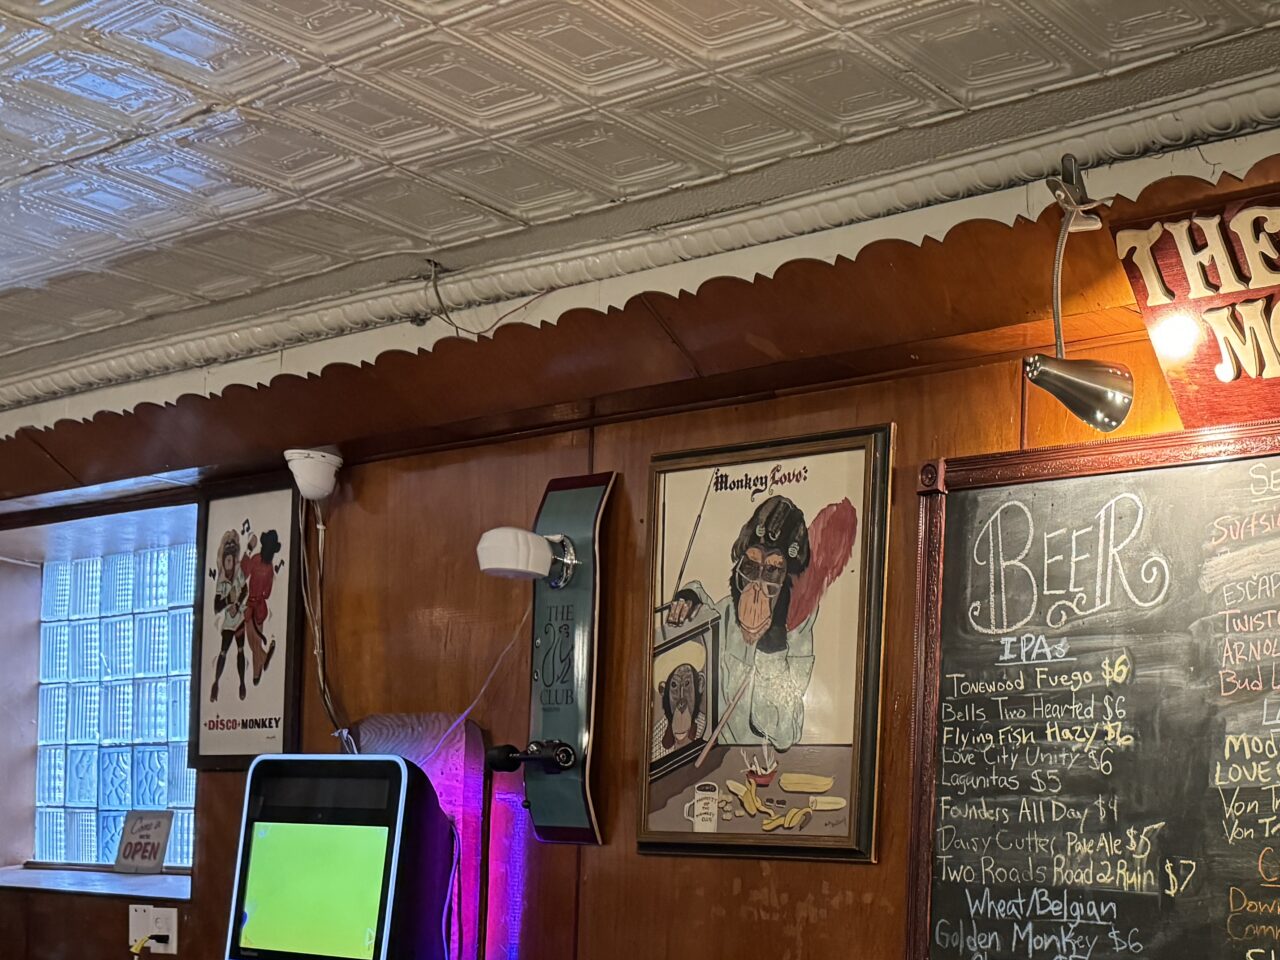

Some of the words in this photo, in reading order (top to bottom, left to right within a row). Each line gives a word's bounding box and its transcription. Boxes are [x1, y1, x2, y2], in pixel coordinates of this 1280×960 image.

[714, 470, 768, 502] Monkey
[547, 605, 574, 621] THE
[1000, 634, 1069, 661] IPAs
[1036, 668, 1093, 691] Fuego
[1218, 665, 1263, 696] Bud
[540, 688, 574, 705] CLUB
[942, 701, 986, 722] Bells
[991, 697, 1026, 720] Two
[1033, 694, 1094, 720] Hearted
[1103, 695, 1126, 720] $6
[241, 717, 281, 729] MONKEY
[943, 726, 993, 750] Flying
[998, 728, 1036, 749] Fish
[1045, 723, 1098, 752] Hazy
[942, 747, 975, 766] Love
[983, 748, 1018, 771] City
[1026, 748, 1080, 770] Unity
[1088, 748, 1113, 774] $6
[1214, 761, 1271, 786] LOVE
[942, 768, 1019, 795] Lagunitas
[1030, 769, 1061, 792] $5
[941, 797, 1009, 823] Founders
[1018, 798, 1044, 823] All
[1052, 800, 1088, 833] Day
[1094, 794, 1118, 821] $4
[1218, 785, 1259, 819] Von
[937, 825, 991, 853] Daisy
[1066, 831, 1094, 856] Pale
[1096, 831, 1122, 857] Ale
[1126, 822, 1165, 858] $5
[1223, 820, 1254, 844] Von
[122, 842, 160, 860] OPEN
[981, 856, 1047, 884] Roads
[1053, 853, 1093, 885] Road
[1096, 861, 1114, 883] 2
[1164, 859, 1196, 897] $7
[935, 919, 1000, 952] Golden
[1012, 922, 1098, 960] Monkey
[1108, 923, 1143, 953] $6
